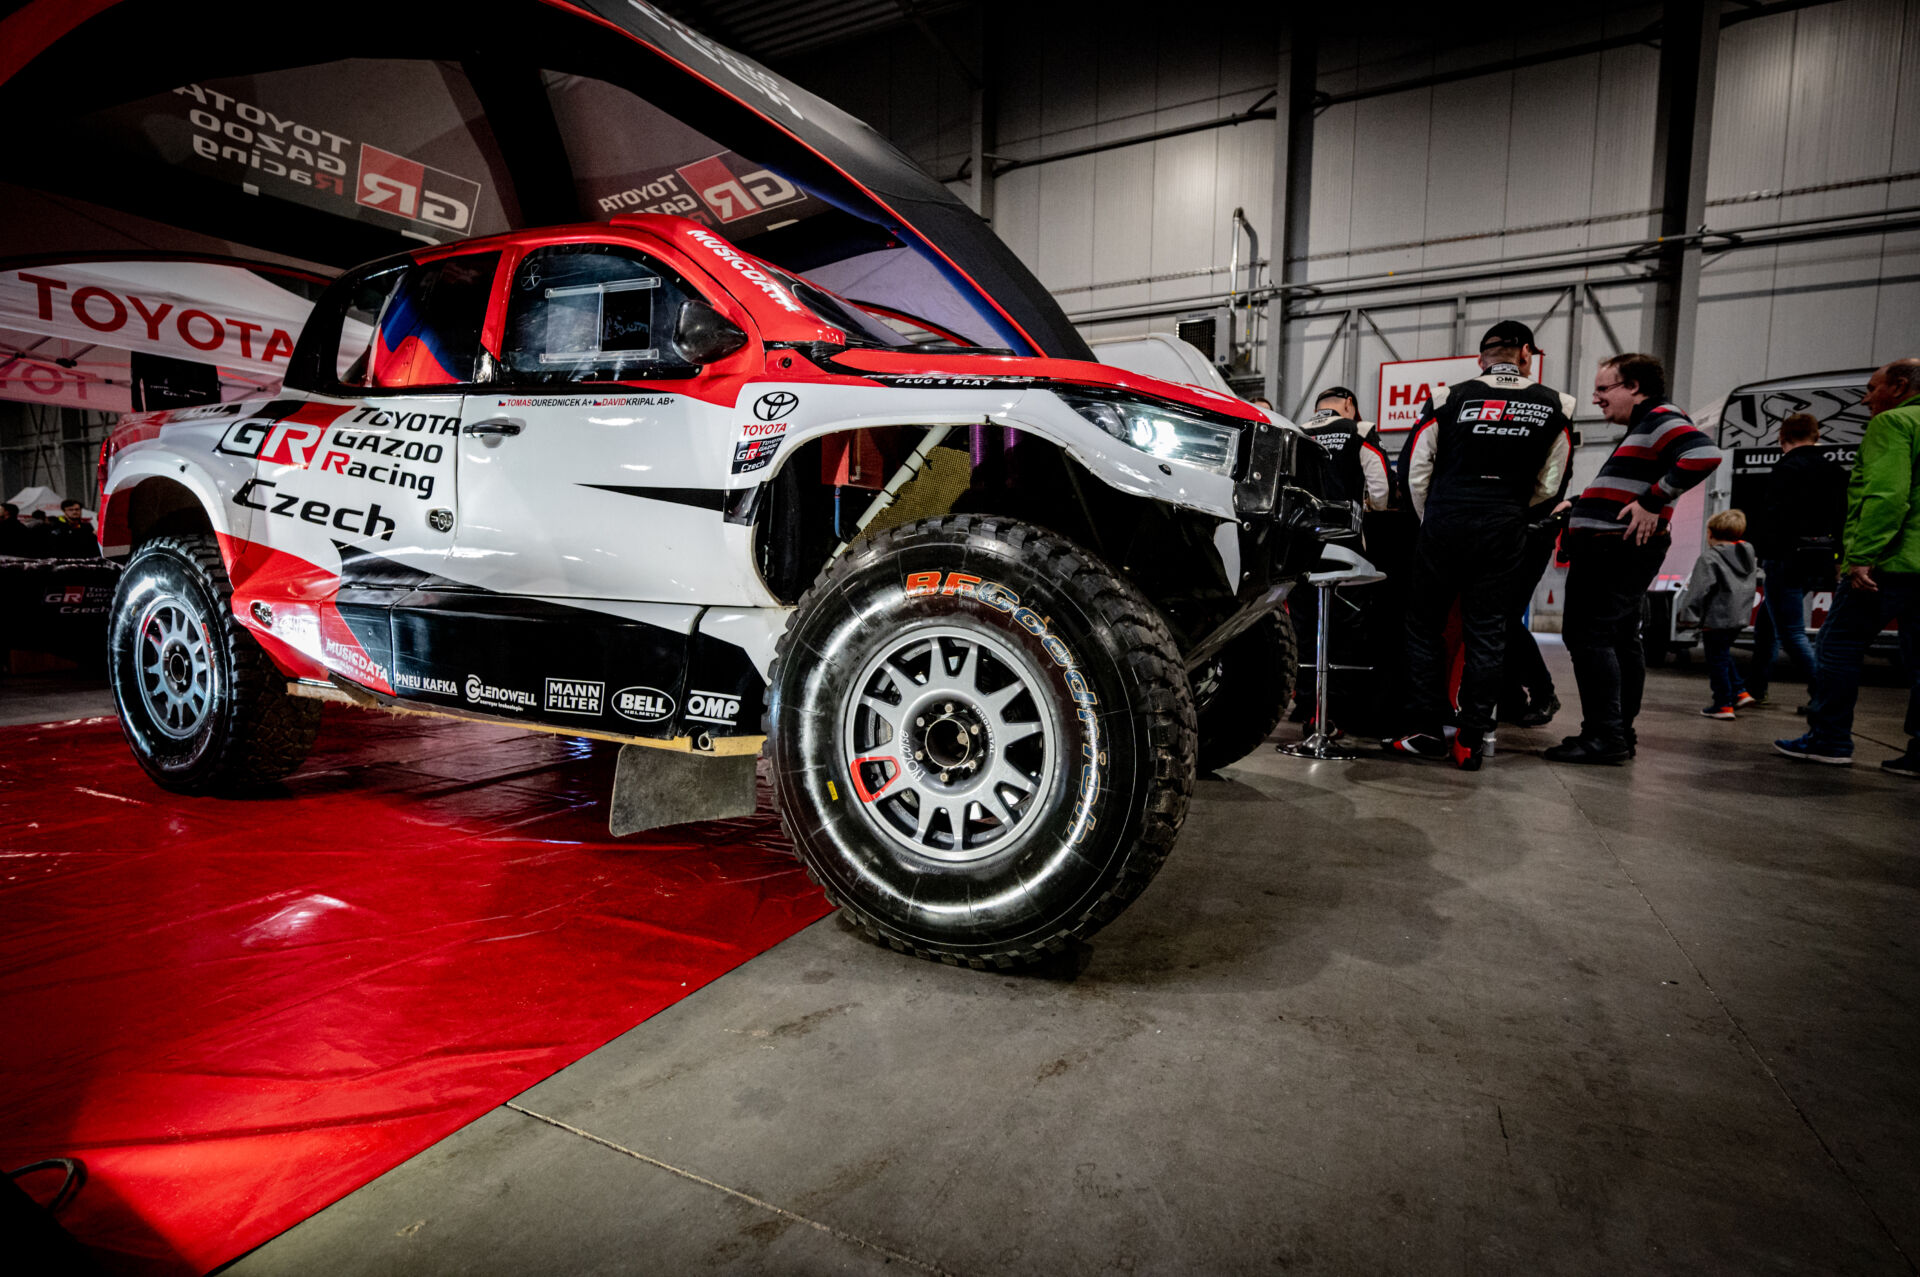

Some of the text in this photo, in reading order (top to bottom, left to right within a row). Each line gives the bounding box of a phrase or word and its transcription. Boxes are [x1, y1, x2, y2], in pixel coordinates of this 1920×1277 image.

[18, 272, 295, 362] TOYOTA
[1460, 407, 1501, 421] GR
[1506, 408, 1549, 419] GAZOO
[1509, 401, 1554, 414] TOYOTA
[352, 407, 462, 436] TOYOTA
[1503, 414, 1546, 427] Racing
[743, 423, 787, 436] TOYOTA
[1472, 424, 1530, 437] Czech
[222, 418, 322, 468] GR
[332, 430, 443, 464] GAZOO
[736, 448, 758, 460] GR
[741, 459, 765, 472] Czech
[321, 450, 435, 500] Racing
[231, 478, 396, 541] Czech
[326, 638, 389, 683] MUSICDATA
[395, 673, 458, 694] PNEU KAFKA
[549, 682, 600, 698] MANN
[549, 694, 599, 711] FILTER
[620, 693, 667, 713] BELL
[687, 695, 740, 719] OMP
[624, 709, 660, 718] HELMETS
